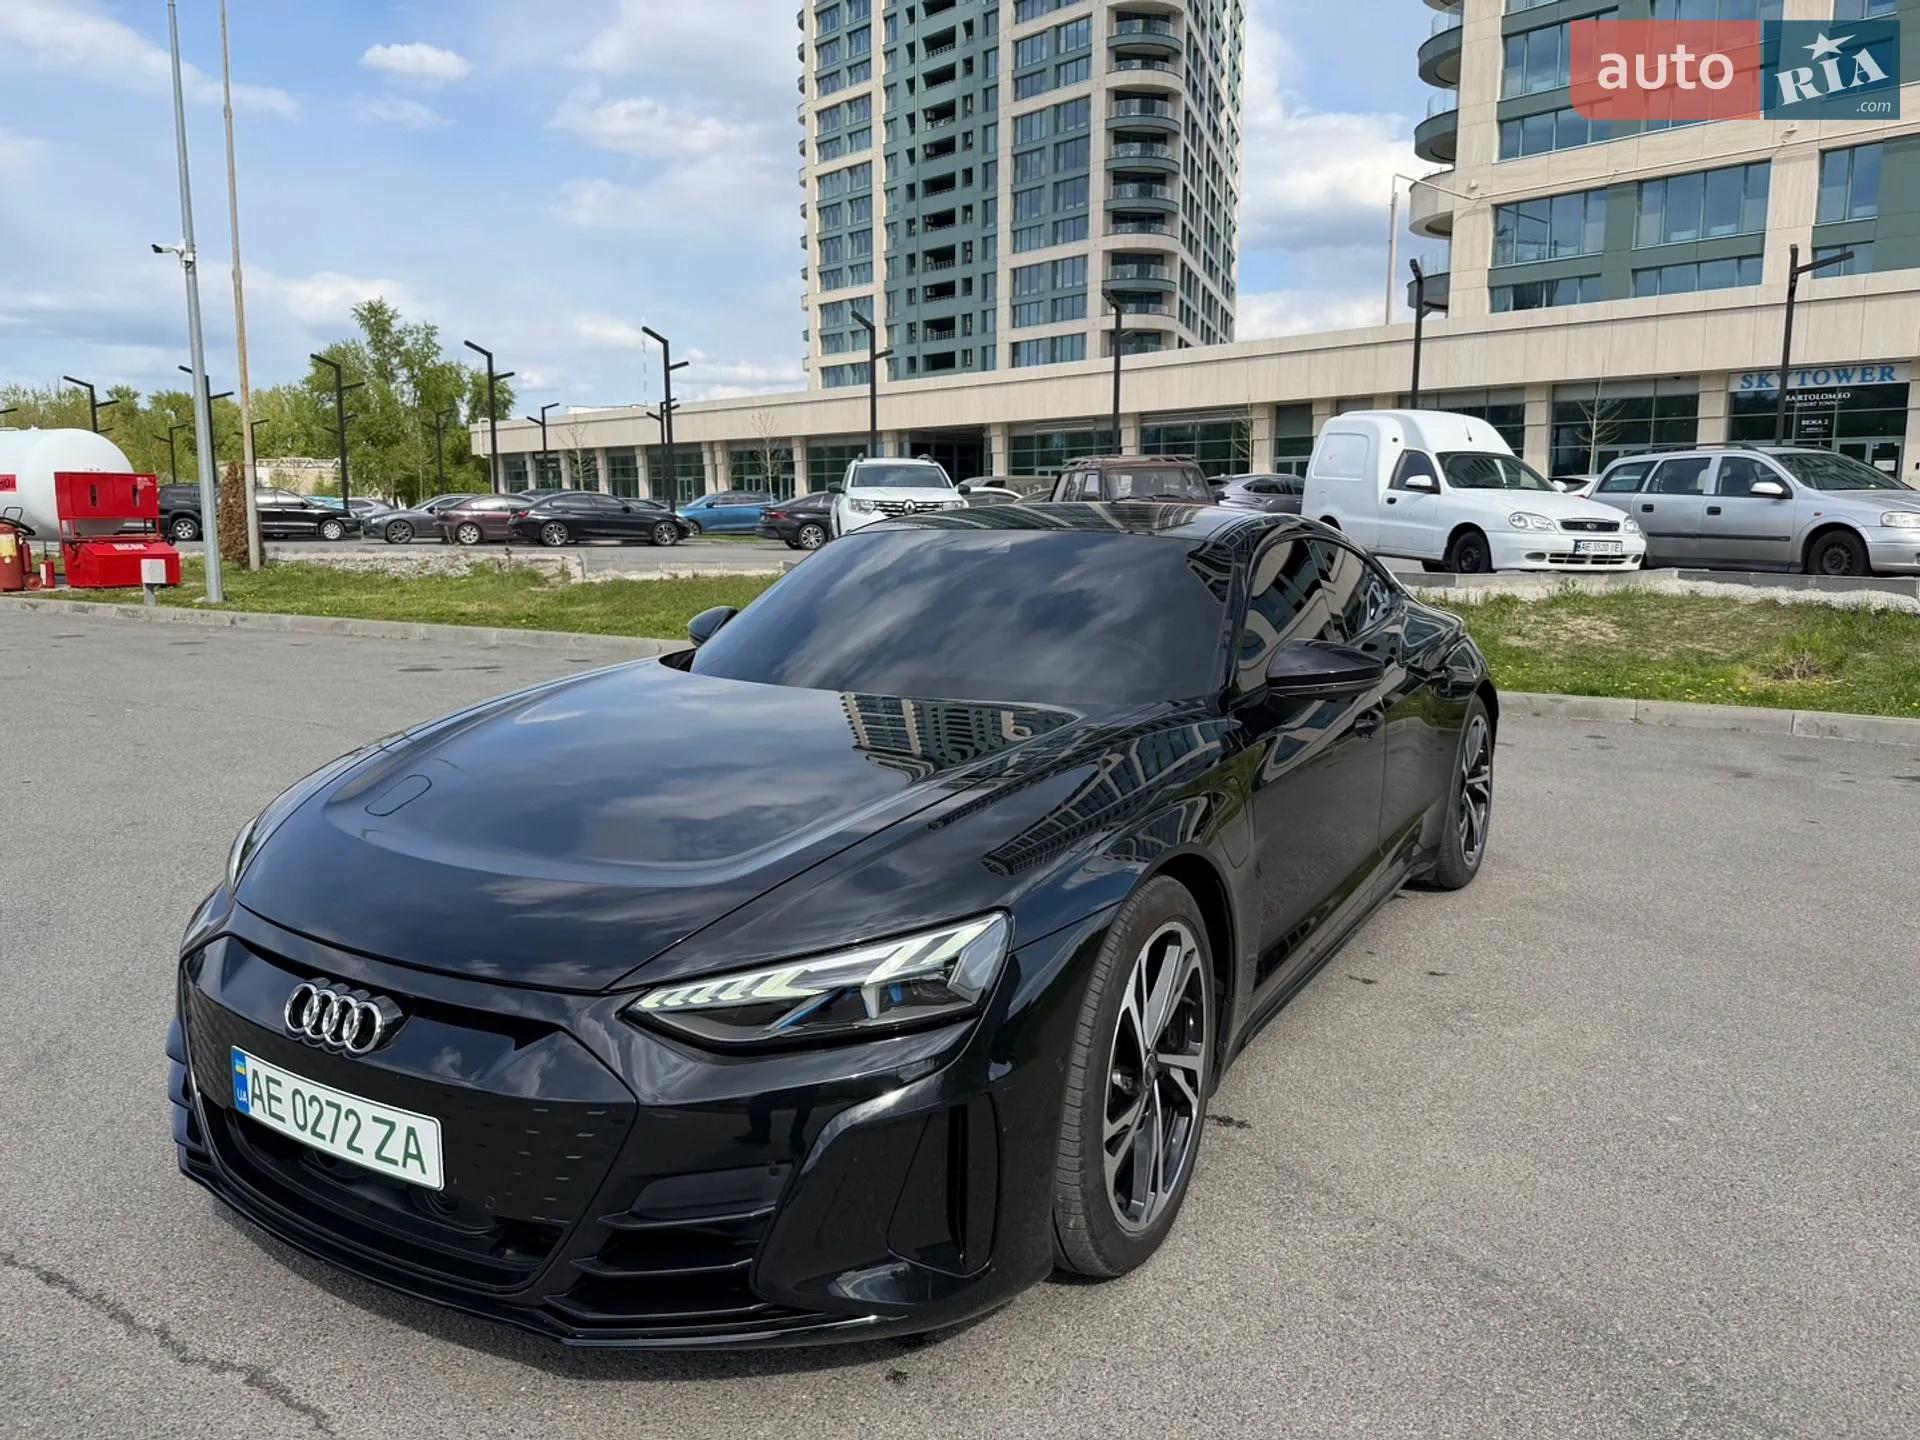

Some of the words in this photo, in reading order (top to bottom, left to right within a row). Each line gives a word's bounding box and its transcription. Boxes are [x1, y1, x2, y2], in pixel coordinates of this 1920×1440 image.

[1785, 391, 1851, 401] BARTOLOMEO
[236, 1088, 248, 1104] UA
[250, 1068, 286, 1124] AE
[292, 1088, 364, 1155] 0272
[372, 1115, 427, 1175] ZA
